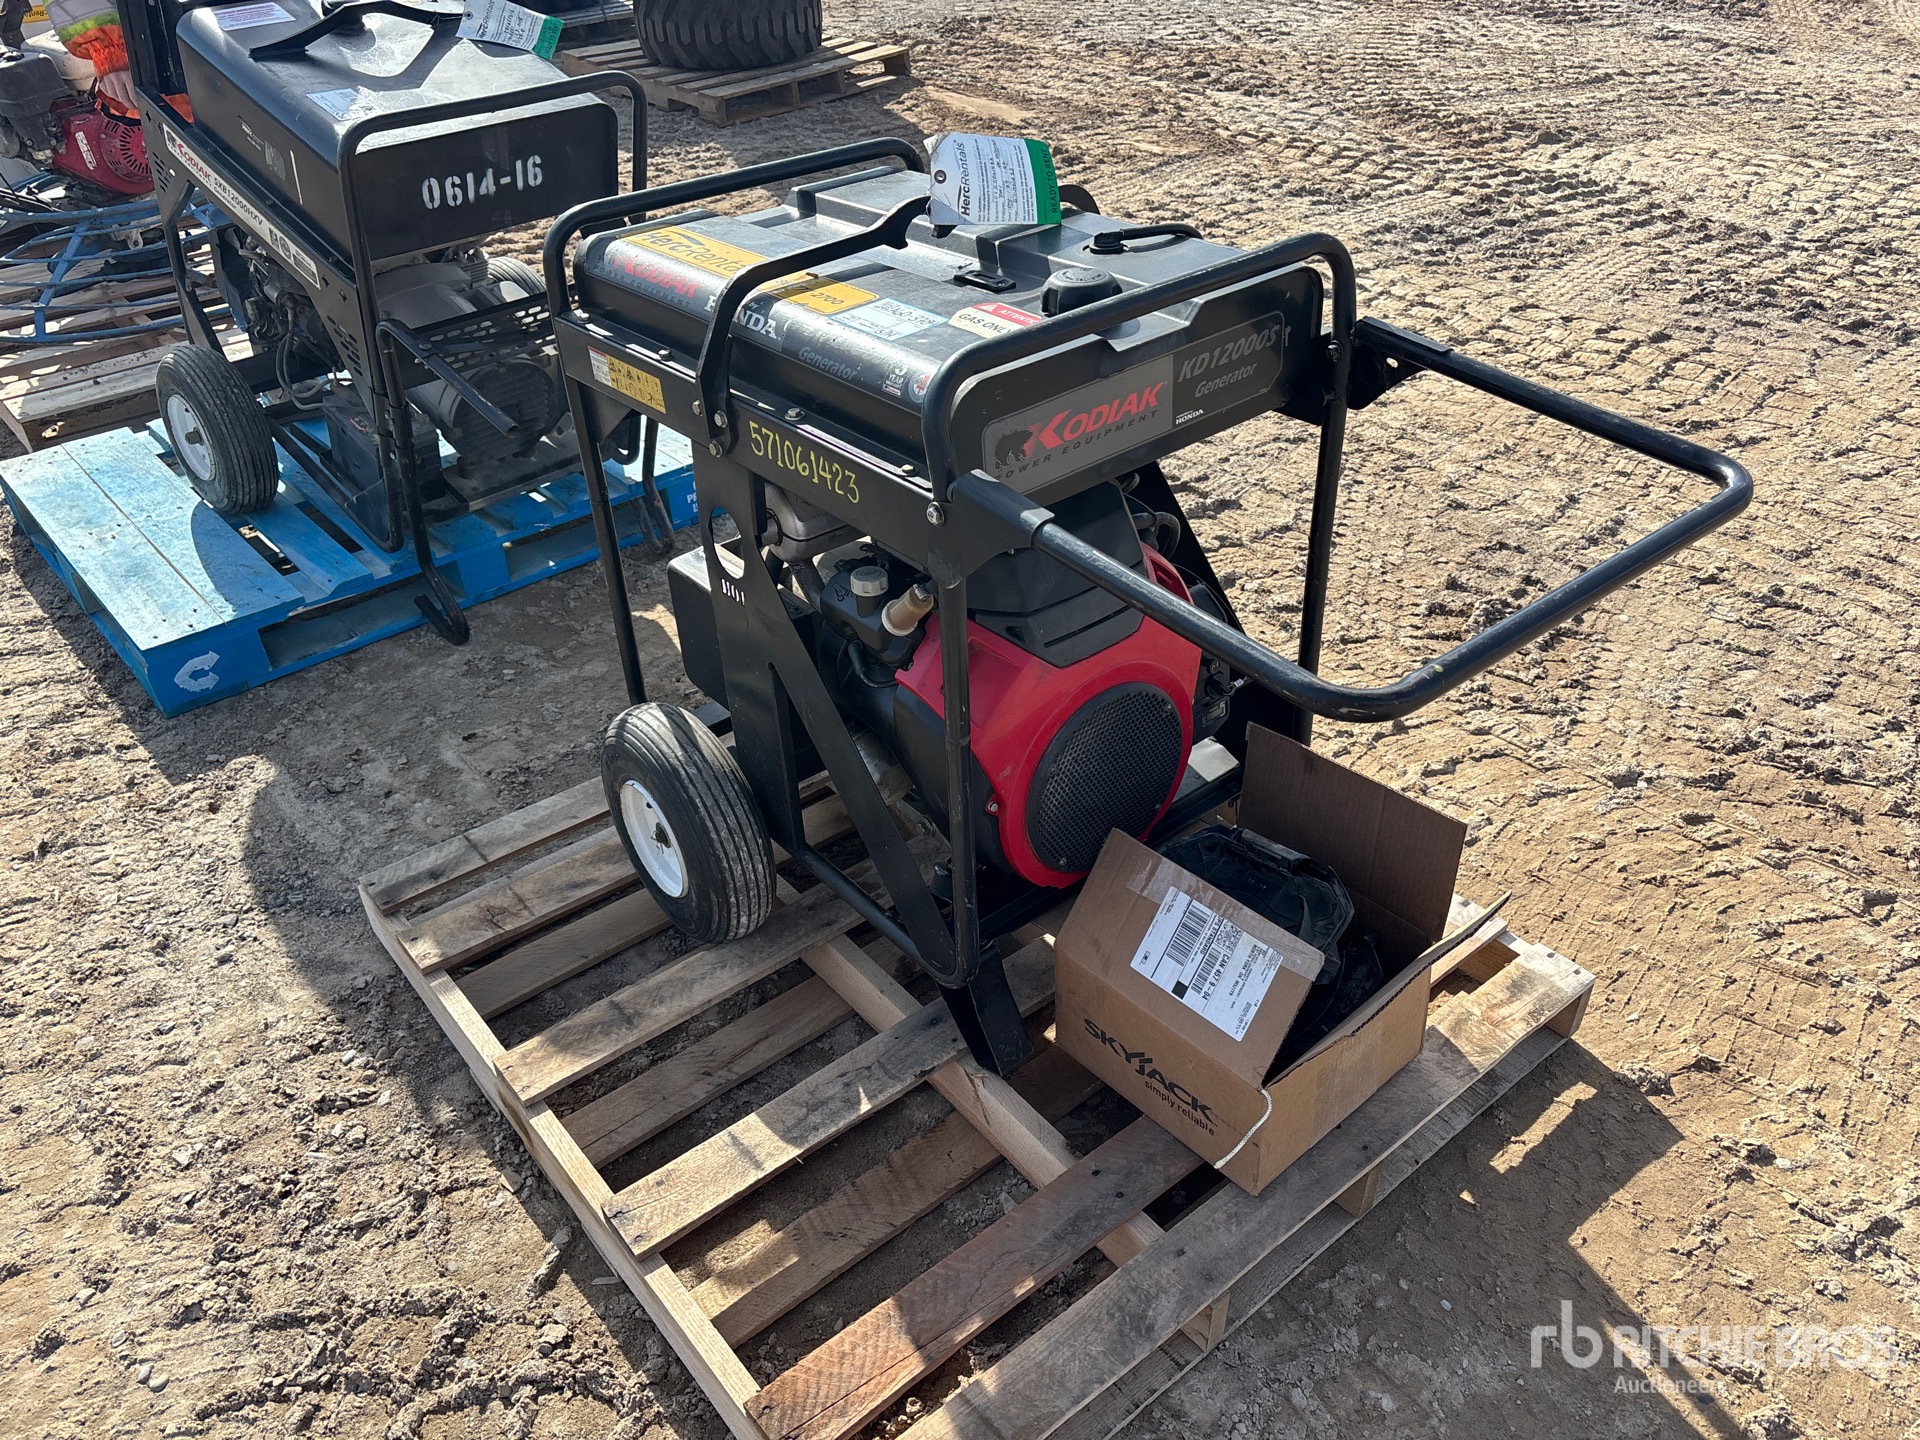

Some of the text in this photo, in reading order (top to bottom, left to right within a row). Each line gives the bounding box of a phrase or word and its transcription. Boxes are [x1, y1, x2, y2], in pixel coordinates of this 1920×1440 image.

[176, 143, 212, 181] KODIAK
[422, 155, 542, 209] 0614-16
[957, 142, 971, 216] HercRentals
[1042, 149, 1058, 212] READY TO RENT
[213, 187, 237, 209] Generator
[643, 231, 744, 273] HercRenta
[621, 258, 701, 298] KODIAK
[630, 280, 691, 308] EQUIPMENT
[704, 294, 778, 340] HNDA
[959, 313, 981, 326] GAS
[799, 346, 857, 381] Generator
[1178, 324, 1280, 383] KD12000S
[1195, 361, 1258, 399] Generator
[1032, 382, 1164, 450] KODIAK
[1175, 408, 1204, 425] HONDA
[749, 421, 860, 504] 571061423
[994, 409, 1158, 481] POWER EQUIPMENT
[1199, 926, 1217, 955] STANDARD
[1217, 953, 1229, 969] CAN
[1211, 967, 1222, 981] 457
[1084, 1018, 1218, 1127] SKYJACK
[1144, 1081, 1215, 1136] simply reliable
